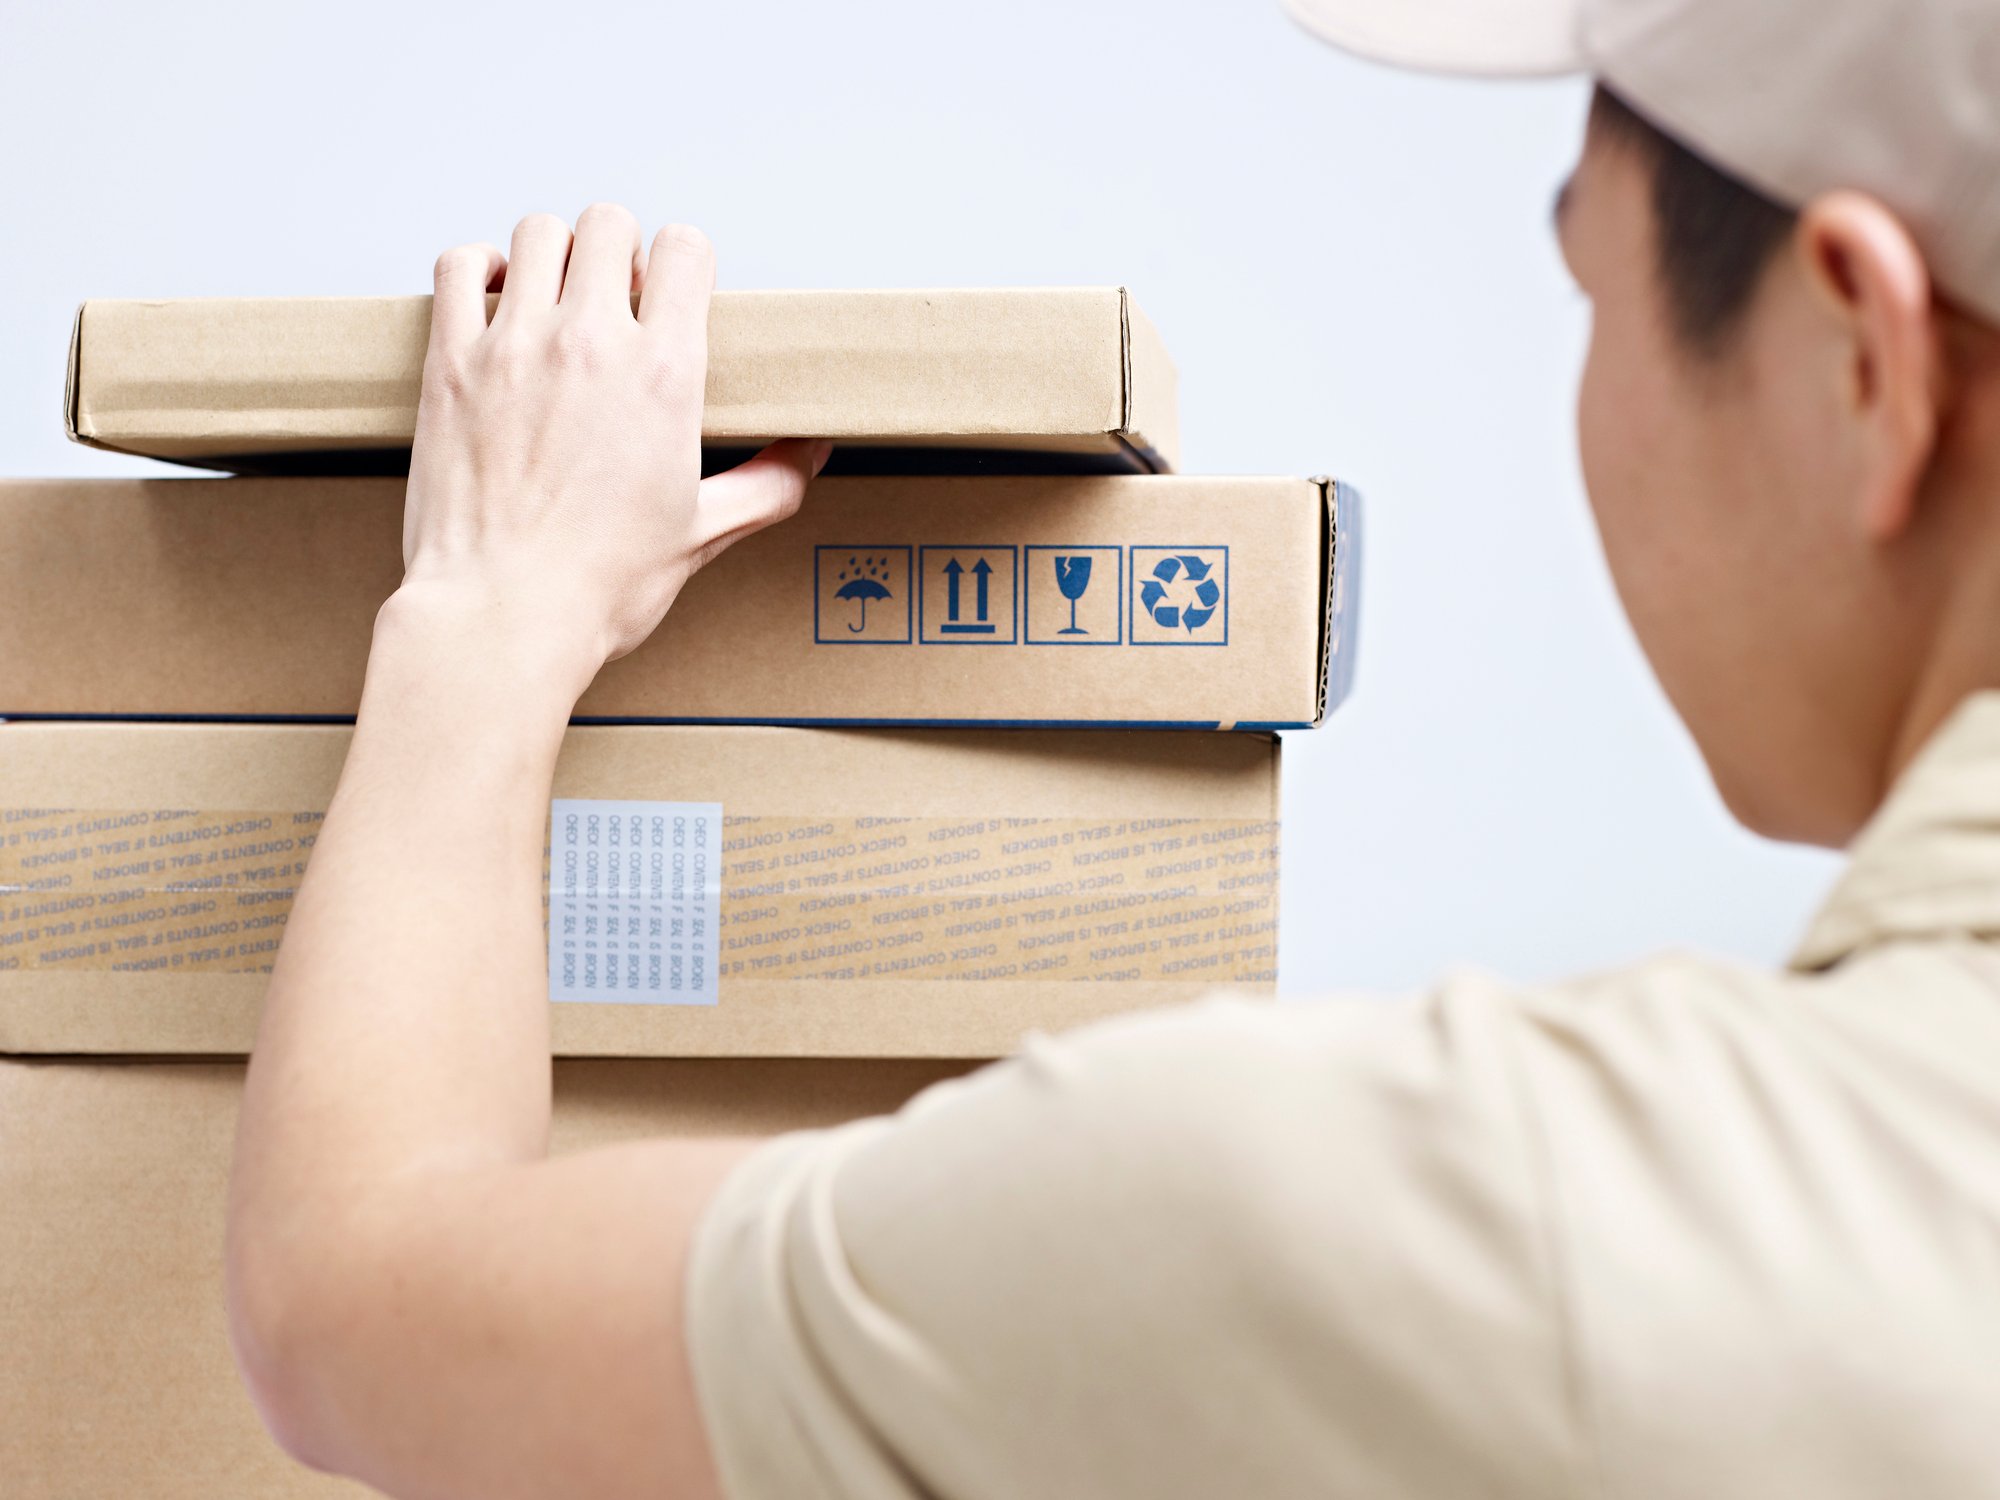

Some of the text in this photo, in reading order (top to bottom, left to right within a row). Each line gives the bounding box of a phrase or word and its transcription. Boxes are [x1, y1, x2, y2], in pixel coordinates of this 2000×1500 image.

[61, 825, 72, 838] IF
[76, 812, 149, 836] CONTENTS
[788, 823, 834, 841] CHECK
[928, 819, 1001, 842] IS BROKEN
[7, 833, 21, 847] IS
[20, 817, 272, 868] CHECK CONTENTS IF SEAL IS BROKEN
[23, 828, 58, 842] SEAL
[1001, 824, 1127, 854] IF SEAL IS BROKEN
[1186, 835, 1198, 847] IF
[222, 838, 294, 861] CONTENTS
[1132, 844, 1146, 857] IS
[1150, 838, 1182, 853] SEAL
[170, 853, 204, 868] SEAL
[206, 851, 218, 863] IF
[731, 835, 907, 875] CHECK CONTENTS IF SEAL
[1073, 847, 1130, 865] BROKEN
[1205, 856, 1218, 869] IS
[1221, 850, 1255, 865] SEAL
[93, 861, 150, 880] BROKEN
[153, 859, 166, 872] IS
[242, 867, 276, 881] SEAL
[278, 864, 291, 877] IF
[1004, 860, 1051, 878] CHECK
[1145, 859, 1202, 879] BROKEN
[225, 873, 239, 887] IS
[727, 849, 980, 901] CHECK CONTENTS IF SEAL IS BROKEN
[928, 869, 1001, 891] CONTENTS
[1078, 873, 1124, 891] CHECK
[99, 887, 145, 905] CHECK
[913, 882, 925, 895] IF
[23, 896, 95, 919] CONTENTS
[170, 900, 216, 917] CHECK
[799, 894, 856, 912] BROKEN
[950, 897, 982, 912] SEAL
[986, 894, 997, 907] IF
[9, 908, 21, 921] IF
[94, 907, 167, 929] CONTENTS
[731, 907, 779, 924] CHECK
[872, 906, 929, 925] BROKEN
[932, 903, 945, 916] IS
[944, 885, 1196, 937] CHECK CONTENTS IF SEAL IS BROKEN
[42, 922, 75, 937] SEAL
[80, 920, 92, 933] IF
[804, 919, 851, 937] CHECK
[1018, 896, 1269, 950] CHECK CONTENTS IF SEAL IS BROKEN
[27, 929, 40, 941] IS
[152, 933, 164, 946] IF
[166, 921, 239, 943] CONTENTS
[728, 928, 800, 949] CONTENTS
[877, 931, 924, 948] CHECK
[98, 942, 111, 954] IS
[115, 935, 148, 950] SEAL
[800, 939, 873, 962] CONTENTS
[1089, 931, 1214, 961] IF SEAL IS BROKEN
[40, 944, 96, 962] BROKEN
[170, 946, 236, 967] IF SEAL IS
[785, 952, 797, 965] IF
[858, 944, 997, 977] CHECK CONTENTS IF
[1221, 952, 1235, 964] IS
[1239, 945, 1271, 960] SEAL
[732, 961, 744, 973] IS
[749, 954, 782, 970] SEAL
[1022, 955, 1068, 973] CHECK
[1161, 954, 1218, 975] BROKEN
